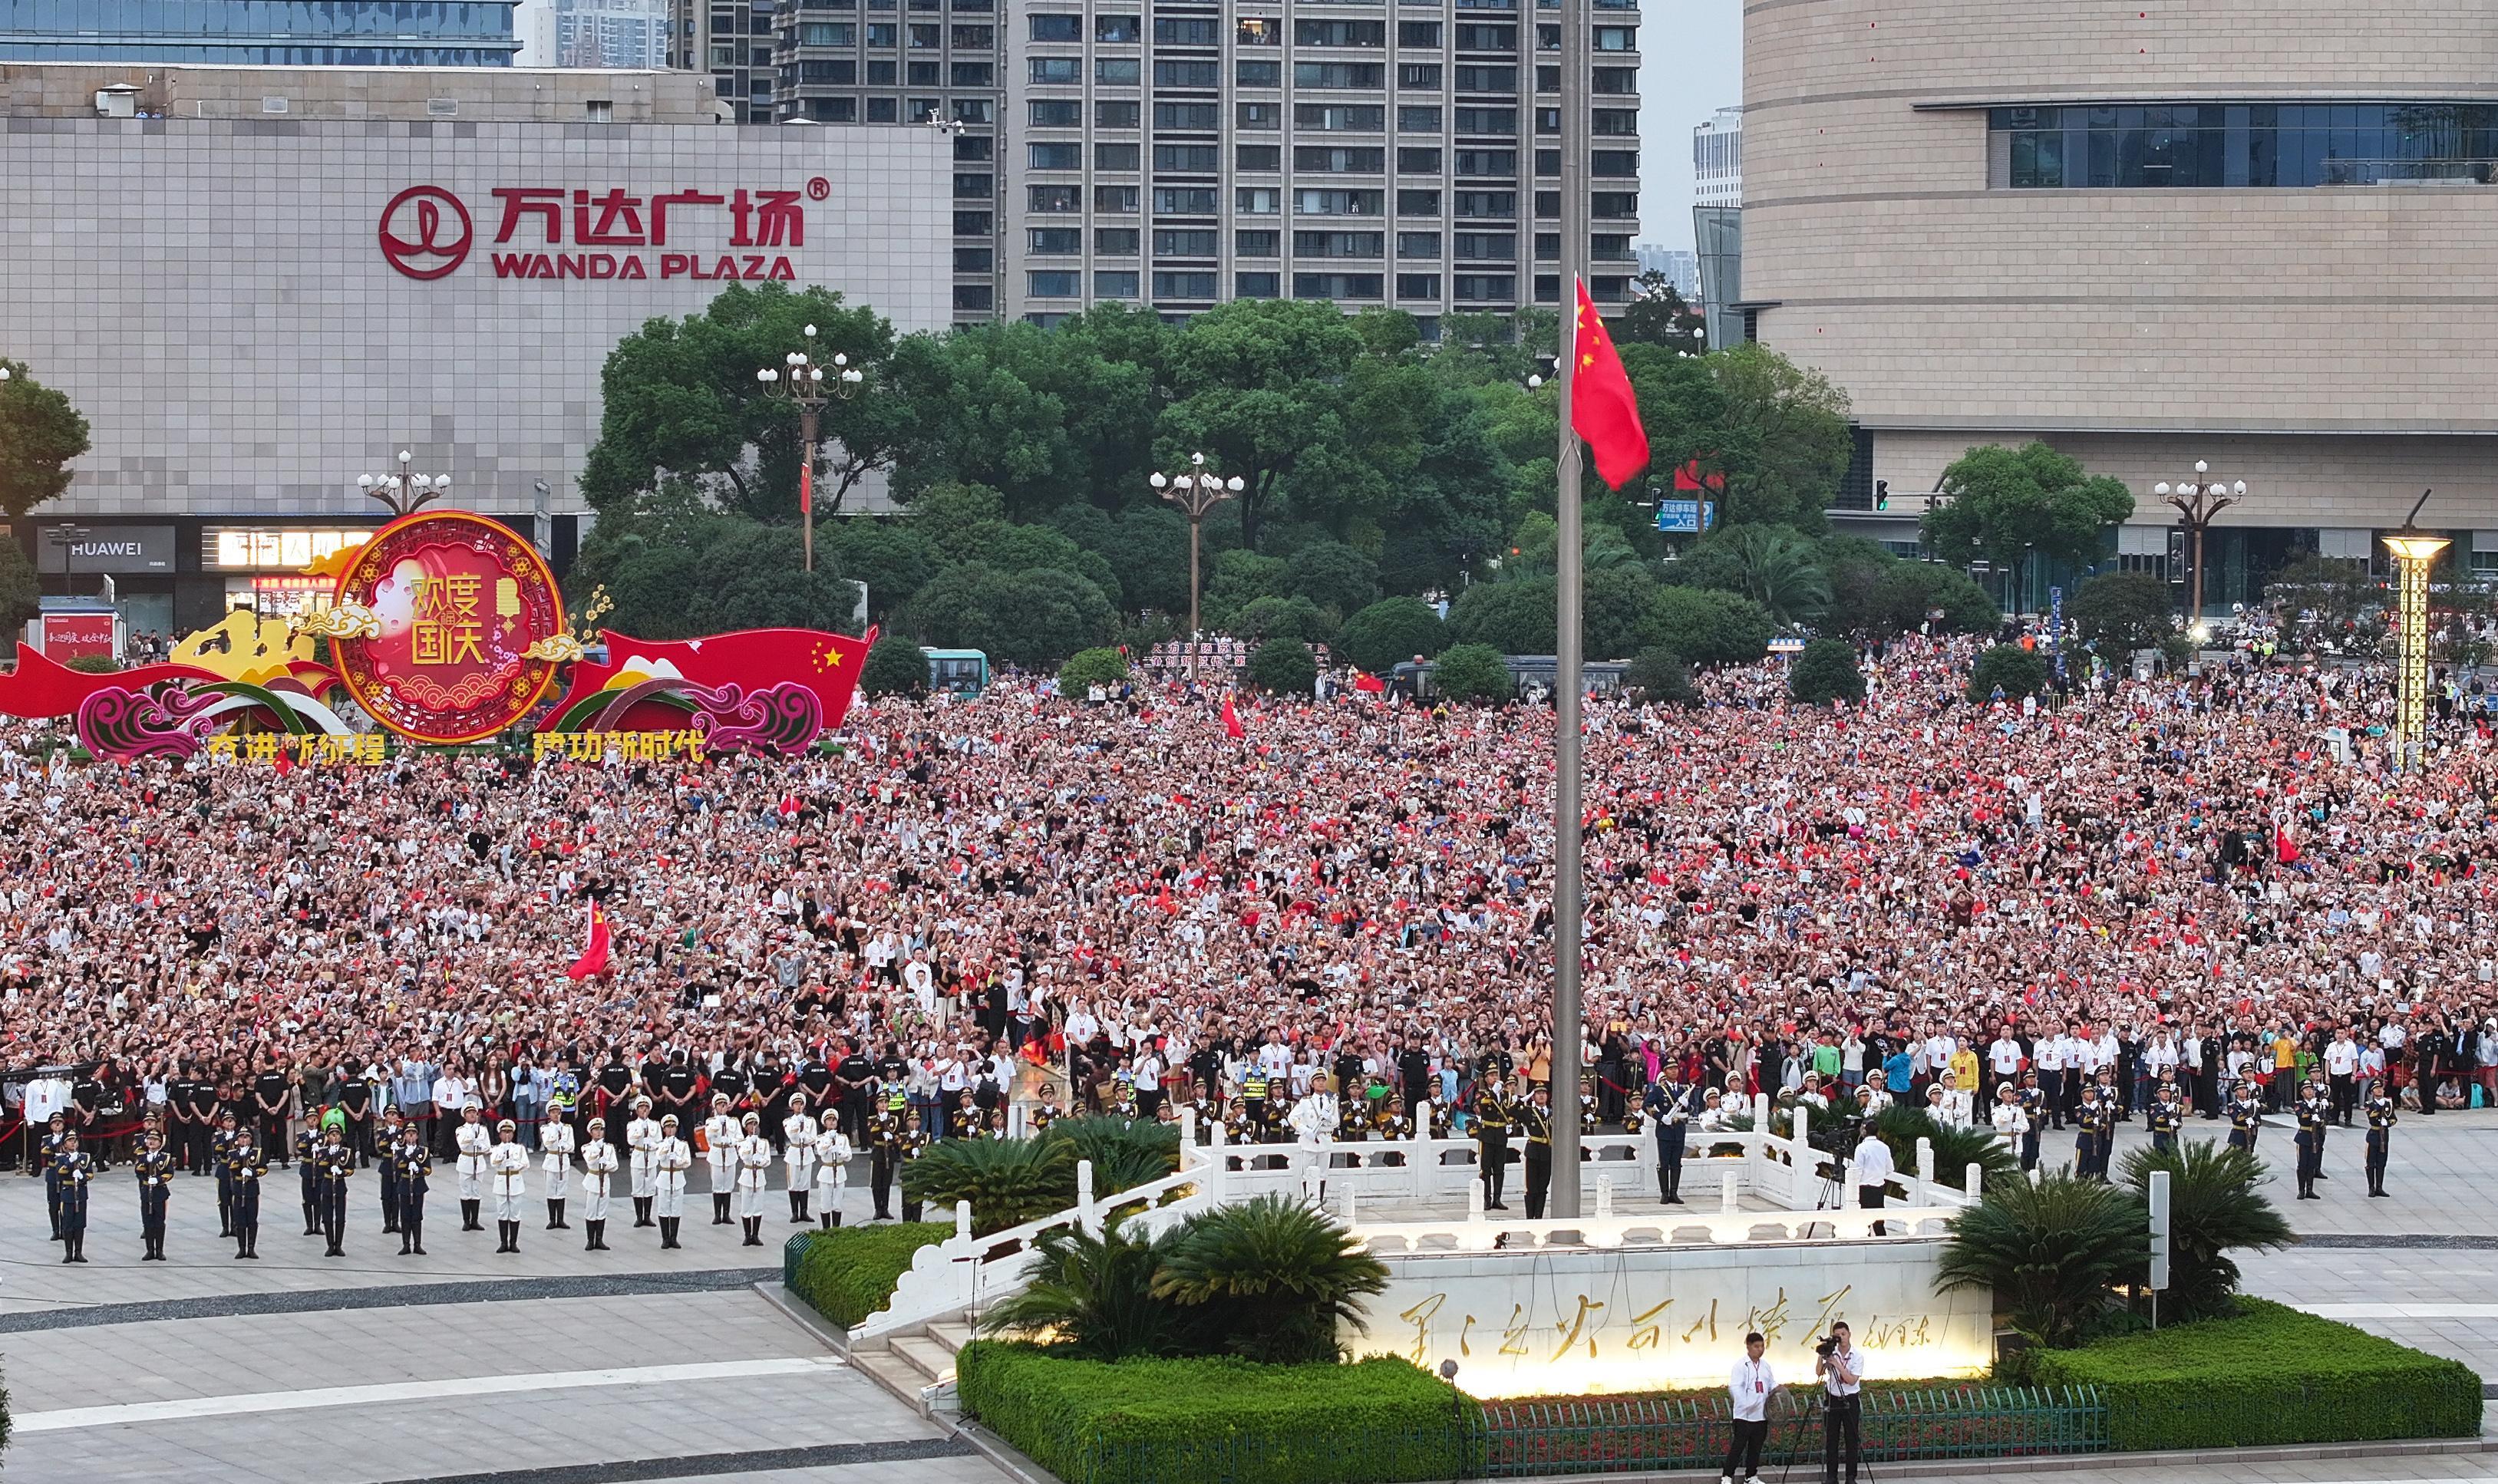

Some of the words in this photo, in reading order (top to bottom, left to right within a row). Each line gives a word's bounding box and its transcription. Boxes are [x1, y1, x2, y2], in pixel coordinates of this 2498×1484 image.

[492, 188, 804, 246] 万达广场
[491, 253, 647, 279] WANDA
[661, 255, 796, 280] PLAZA
[1663, 503, 1697, 513] 万达停车场
[1676, 519, 1696, 527] 入口
[71, 542, 141, 556] HUAWEI
[411, 572, 482, 618] 欢度
[412, 619, 485, 665] 国庆
[533, 729, 706, 763] 建功新时代
